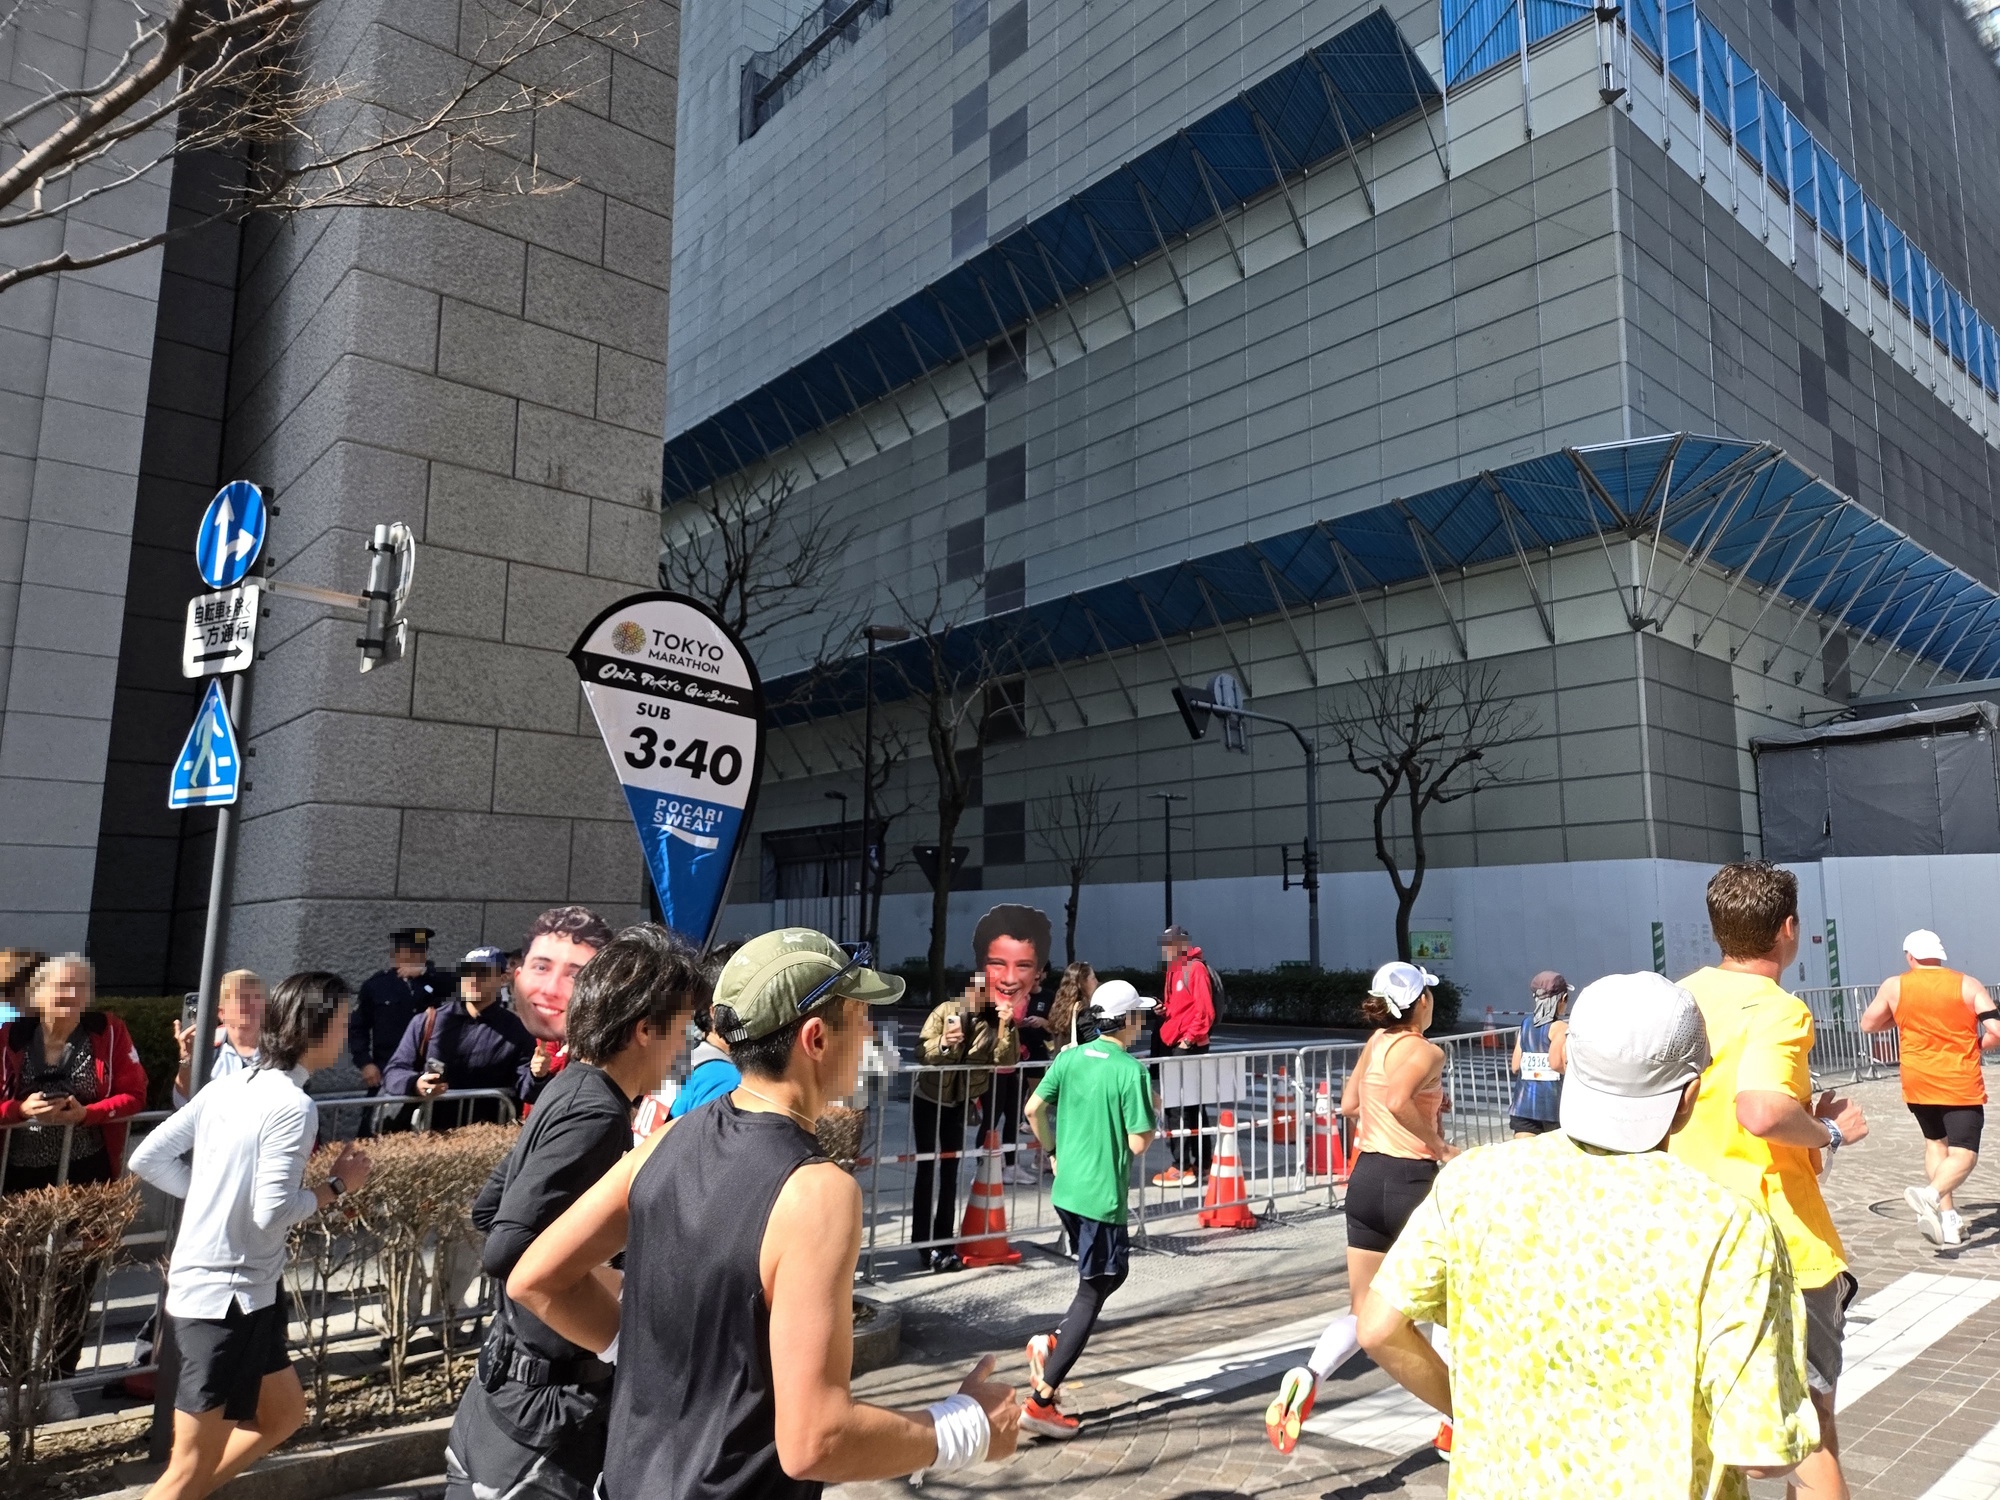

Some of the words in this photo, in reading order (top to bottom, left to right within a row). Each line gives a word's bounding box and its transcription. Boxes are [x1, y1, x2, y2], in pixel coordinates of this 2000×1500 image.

[195, 597, 252, 624] 自転車を除く
[193, 621, 250, 647] 一方通行
[652, 629, 724, 661] TOKYO
[648, 648, 721, 675] MARATHON
[636, 702, 671, 720] SUB
[624, 726, 743, 786] 3:40
[653, 811, 714, 833] SWEAT
[655, 798, 723, 823] POCARI
